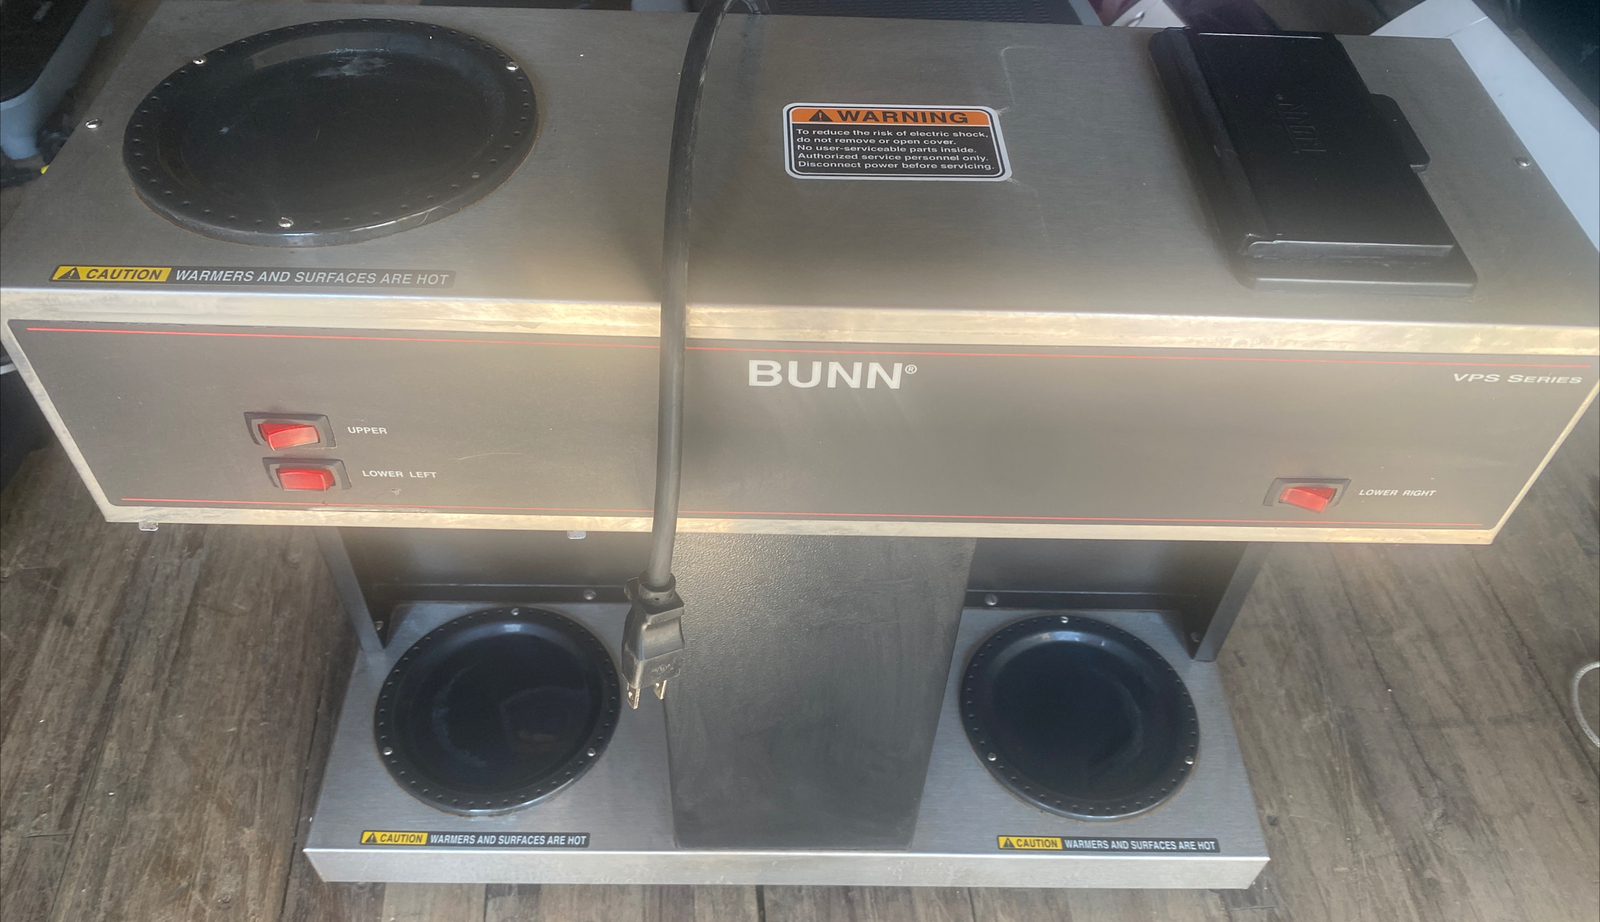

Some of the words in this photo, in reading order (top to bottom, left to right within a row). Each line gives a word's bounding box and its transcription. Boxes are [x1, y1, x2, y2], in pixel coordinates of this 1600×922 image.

[837, 110, 968, 123] WARNING
[812, 128, 850, 136] reduce
[873, 129, 893, 137] risk
[896, 129, 908, 137] of
[796, 136, 811, 144] do
[815, 145, 907, 153] user-serviceable
[909, 146, 937, 154] parts
[798, 152, 858, 160] Authorized
[904, 154, 960, 163] personnel
[962, 155, 989, 163] only.
[798, 160, 861, 169] Disconnect
[864, 162, 899, 170] power
[901, 161, 938, 170] before
[940, 163, 995, 171] servicing.
[85, 268, 162, 281] CAUTION
[175, 269, 254, 283] WARMERS
[257, 271, 289, 284] AND
[294, 271, 376, 285] SURFACES
[380, 273, 412, 285] ARE
[416, 274, 449, 286] HOT
[1453, 373, 1501, 383] VPS
[1507, 374, 1583, 384] SERIES
[347, 426, 388, 435] UPPER
[362, 470, 404, 478] LOWER
[409, 471, 437, 479] LEFT
[1358, 489, 1398, 497] LOWER
[1402, 489, 1437, 497] RIGHT
[379, 833, 424, 844] CAUTION
[430, 834, 476, 845] WARMERS
[477, 835, 495, 846] AND
[498, 835, 546, 846] SURFACES
[547, 835, 565, 846] ARE
[568, 835, 586, 846] HOT
[1016, 839, 1059, 849] CAUTION
[1064, 840, 1110, 850] WARMERS
[1111, 840, 1129, 851] AND
[1130, 840, 1178, 851] SURFACES
[1179, 841, 1197, 851] ARE
[1198, 841, 1216, 851] HOT
